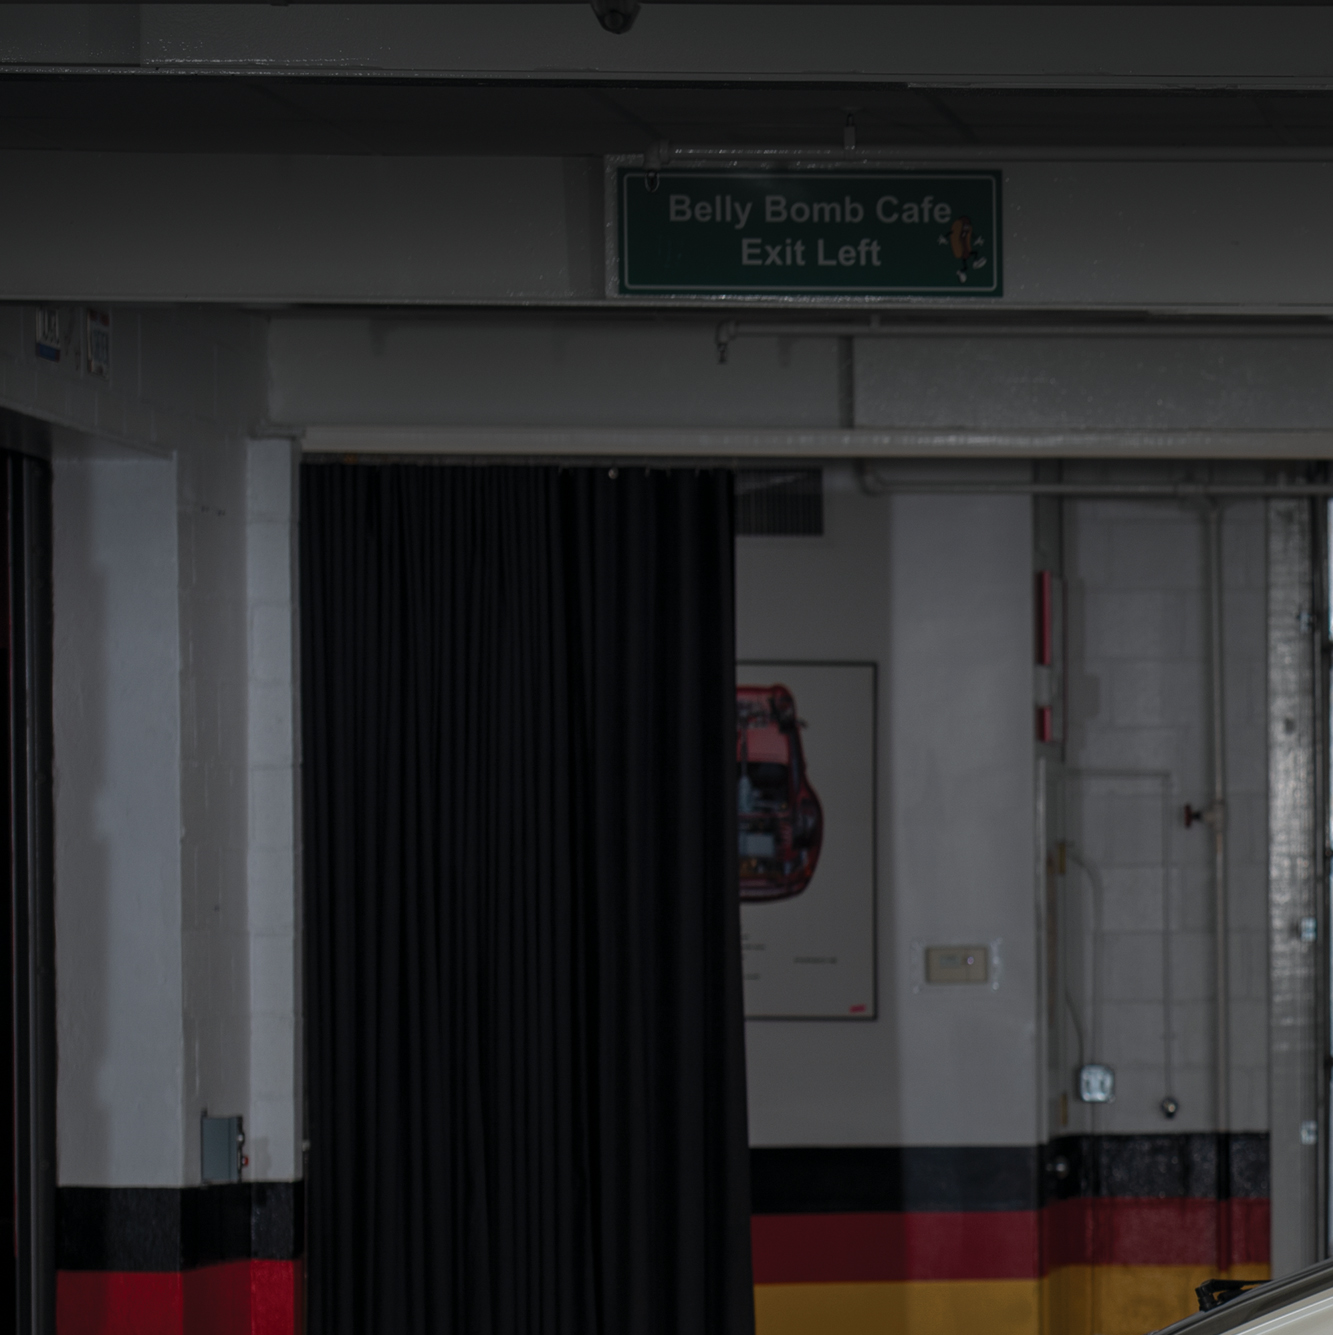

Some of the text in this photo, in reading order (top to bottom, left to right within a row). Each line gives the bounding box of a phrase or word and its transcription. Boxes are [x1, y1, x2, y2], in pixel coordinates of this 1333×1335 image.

[669, 194, 952, 229] Belly Bomb Cafe
[741, 237, 882, 266] Exit Left
